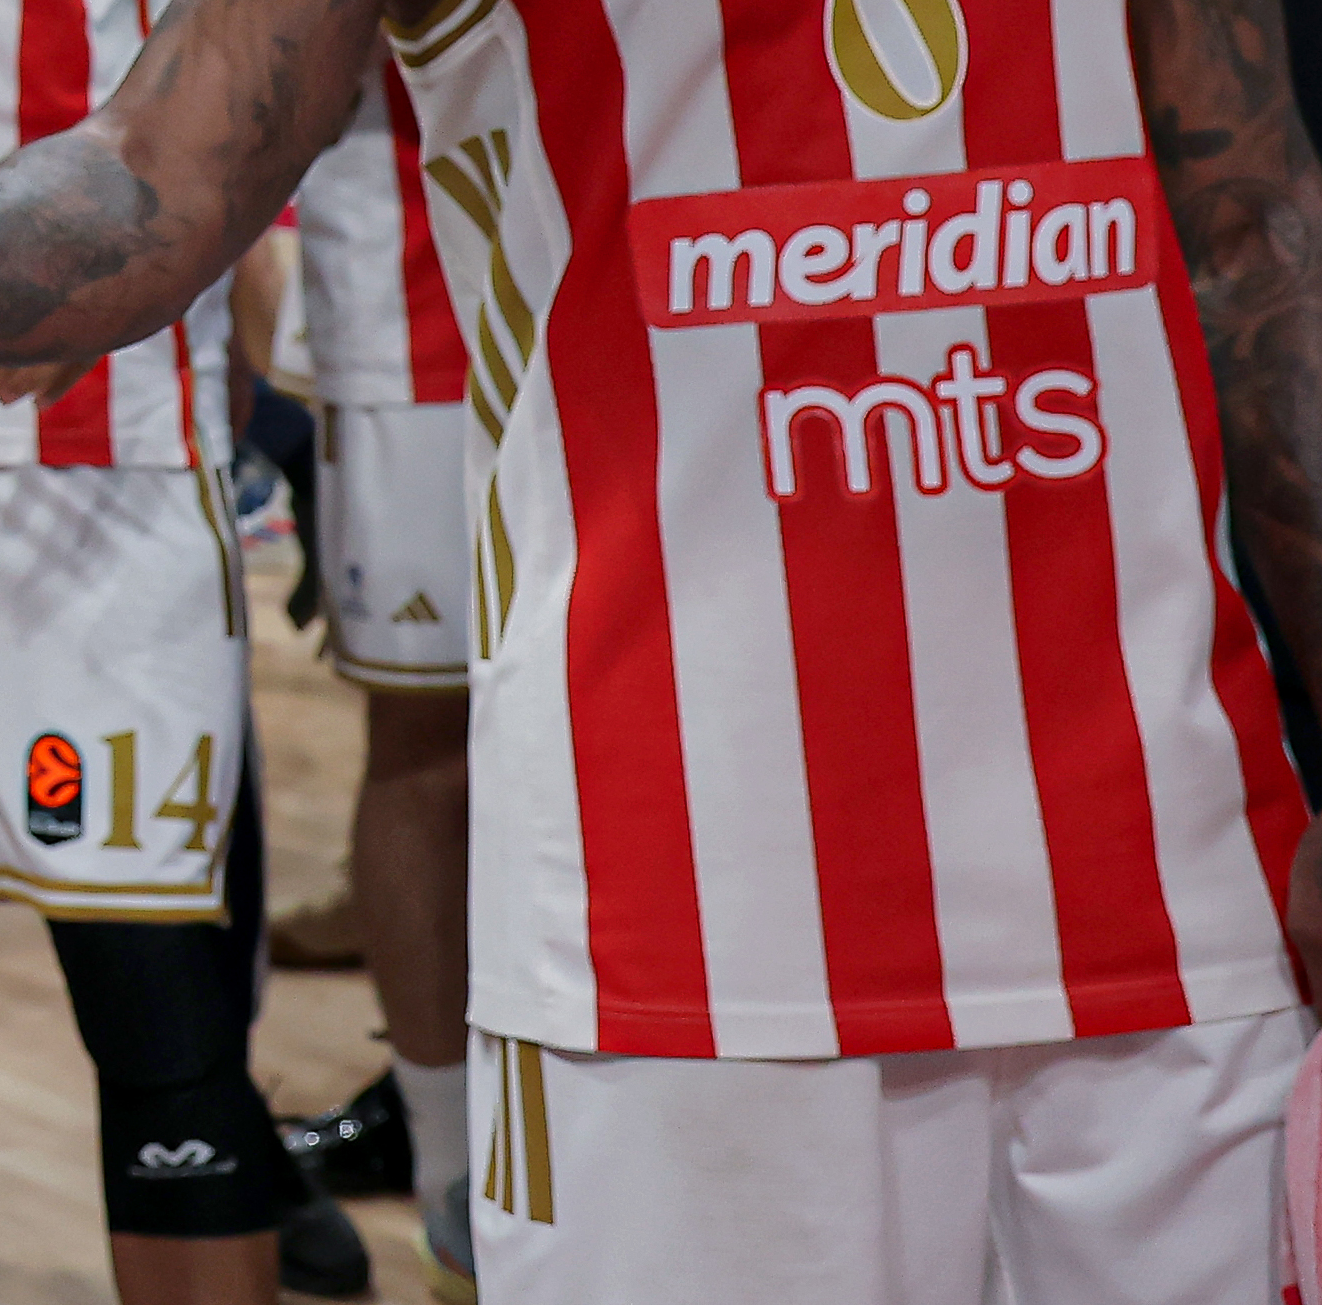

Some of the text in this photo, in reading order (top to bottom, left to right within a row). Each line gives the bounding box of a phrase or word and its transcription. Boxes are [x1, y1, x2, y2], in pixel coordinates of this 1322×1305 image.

[668, 179, 1137, 313] meridian
[761, 343, 1105, 499] mts
[100, 729, 218, 851] 14
